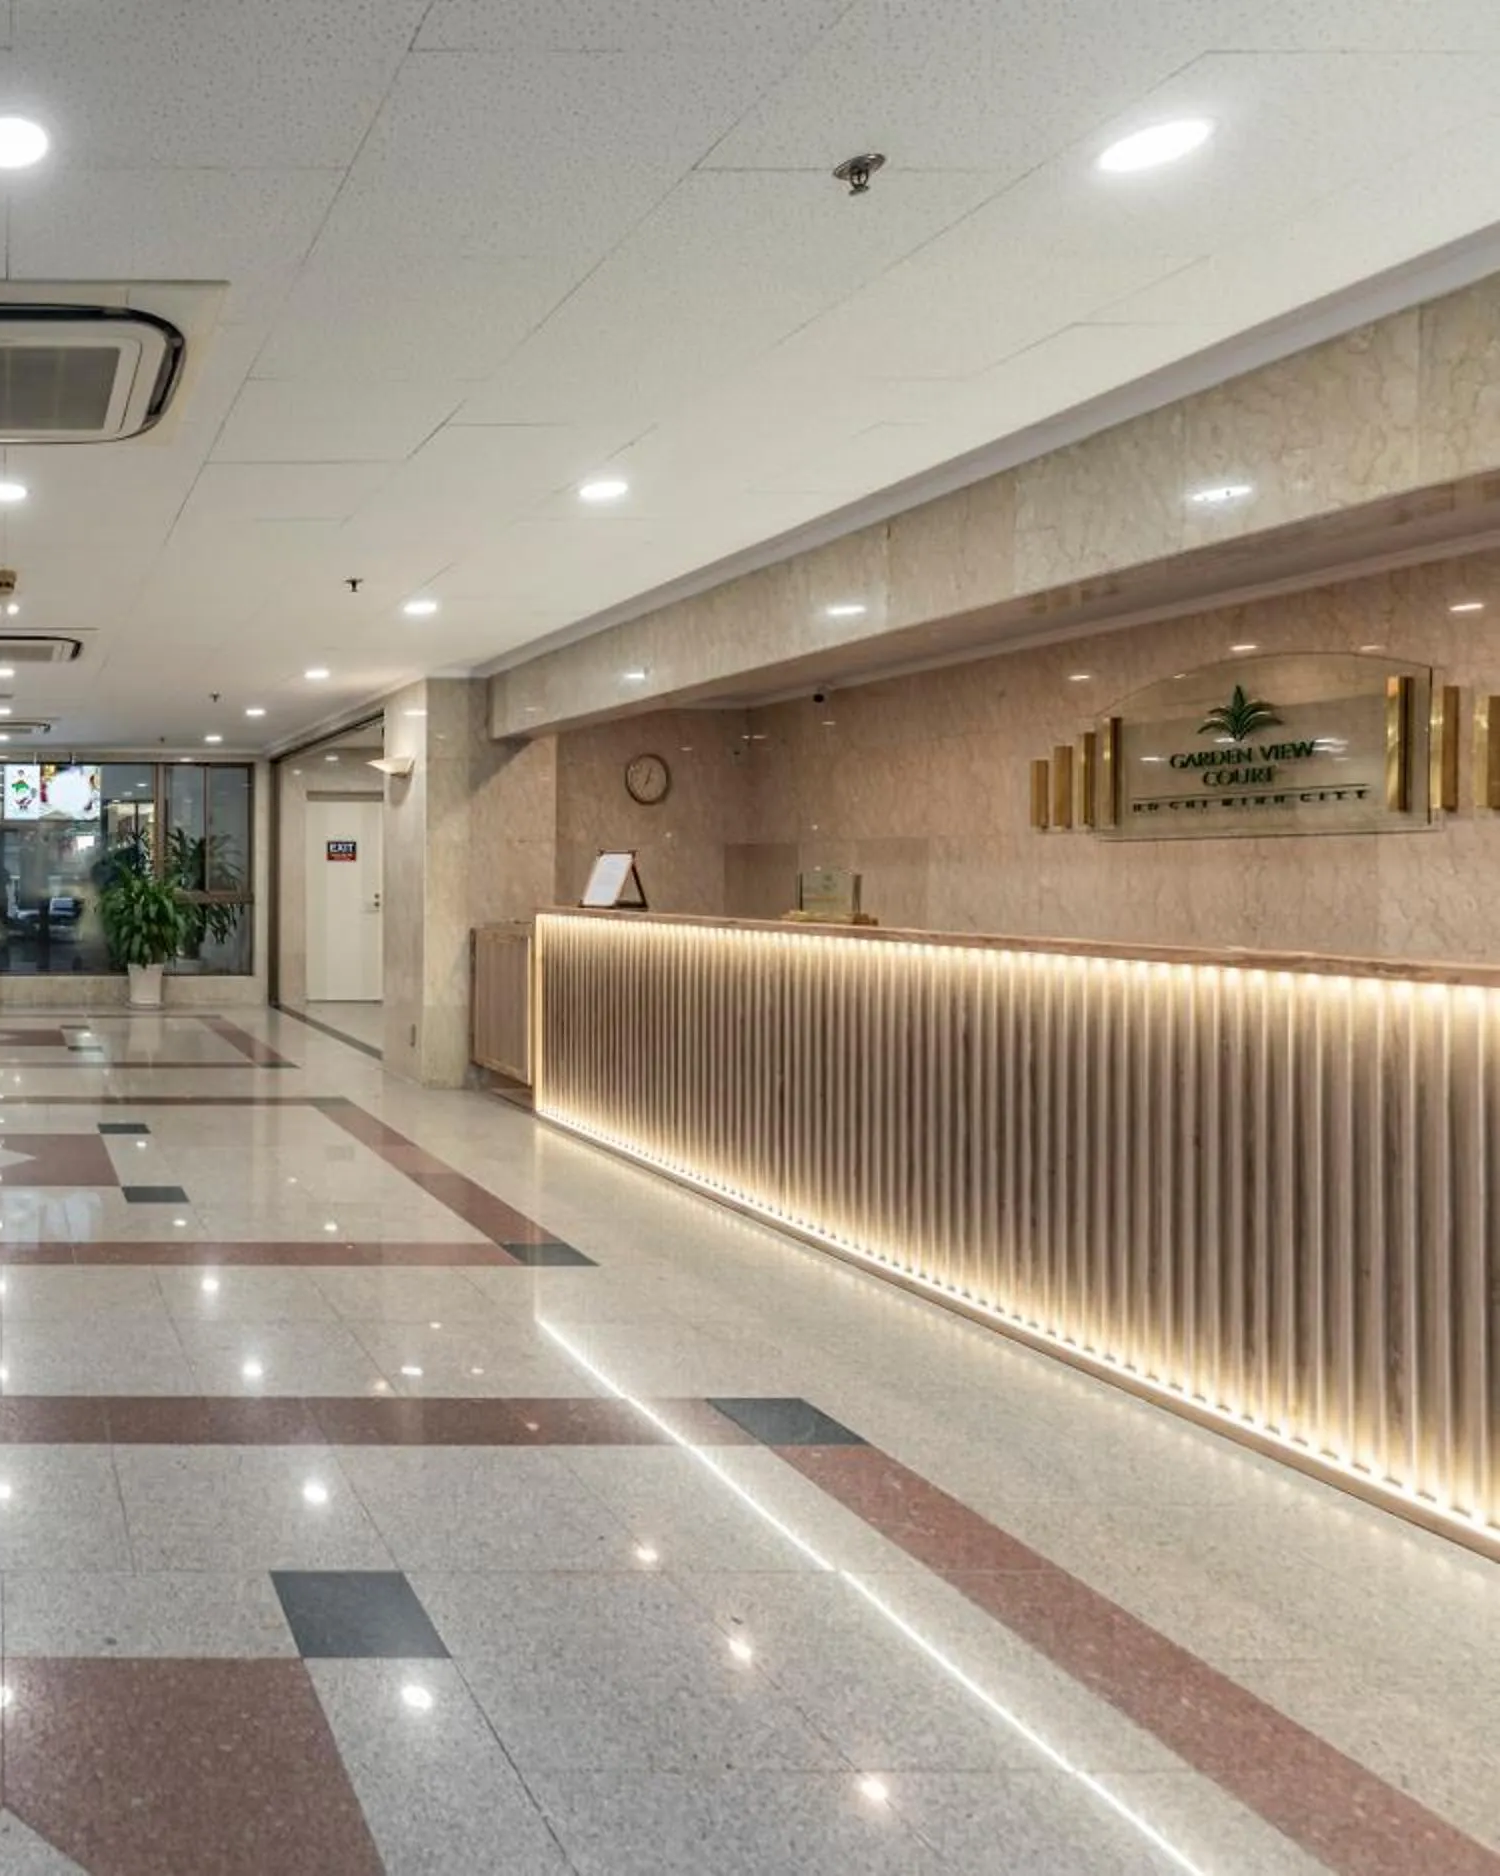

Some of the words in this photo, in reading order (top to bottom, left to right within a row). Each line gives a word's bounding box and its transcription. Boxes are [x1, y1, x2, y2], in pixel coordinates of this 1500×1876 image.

[1169, 748, 1252, 769] GARDEN
[1259, 741, 1316, 761] VIEW
[1202, 766, 1274, 787] COURT
[330, 843, 353, 852] EXIT
